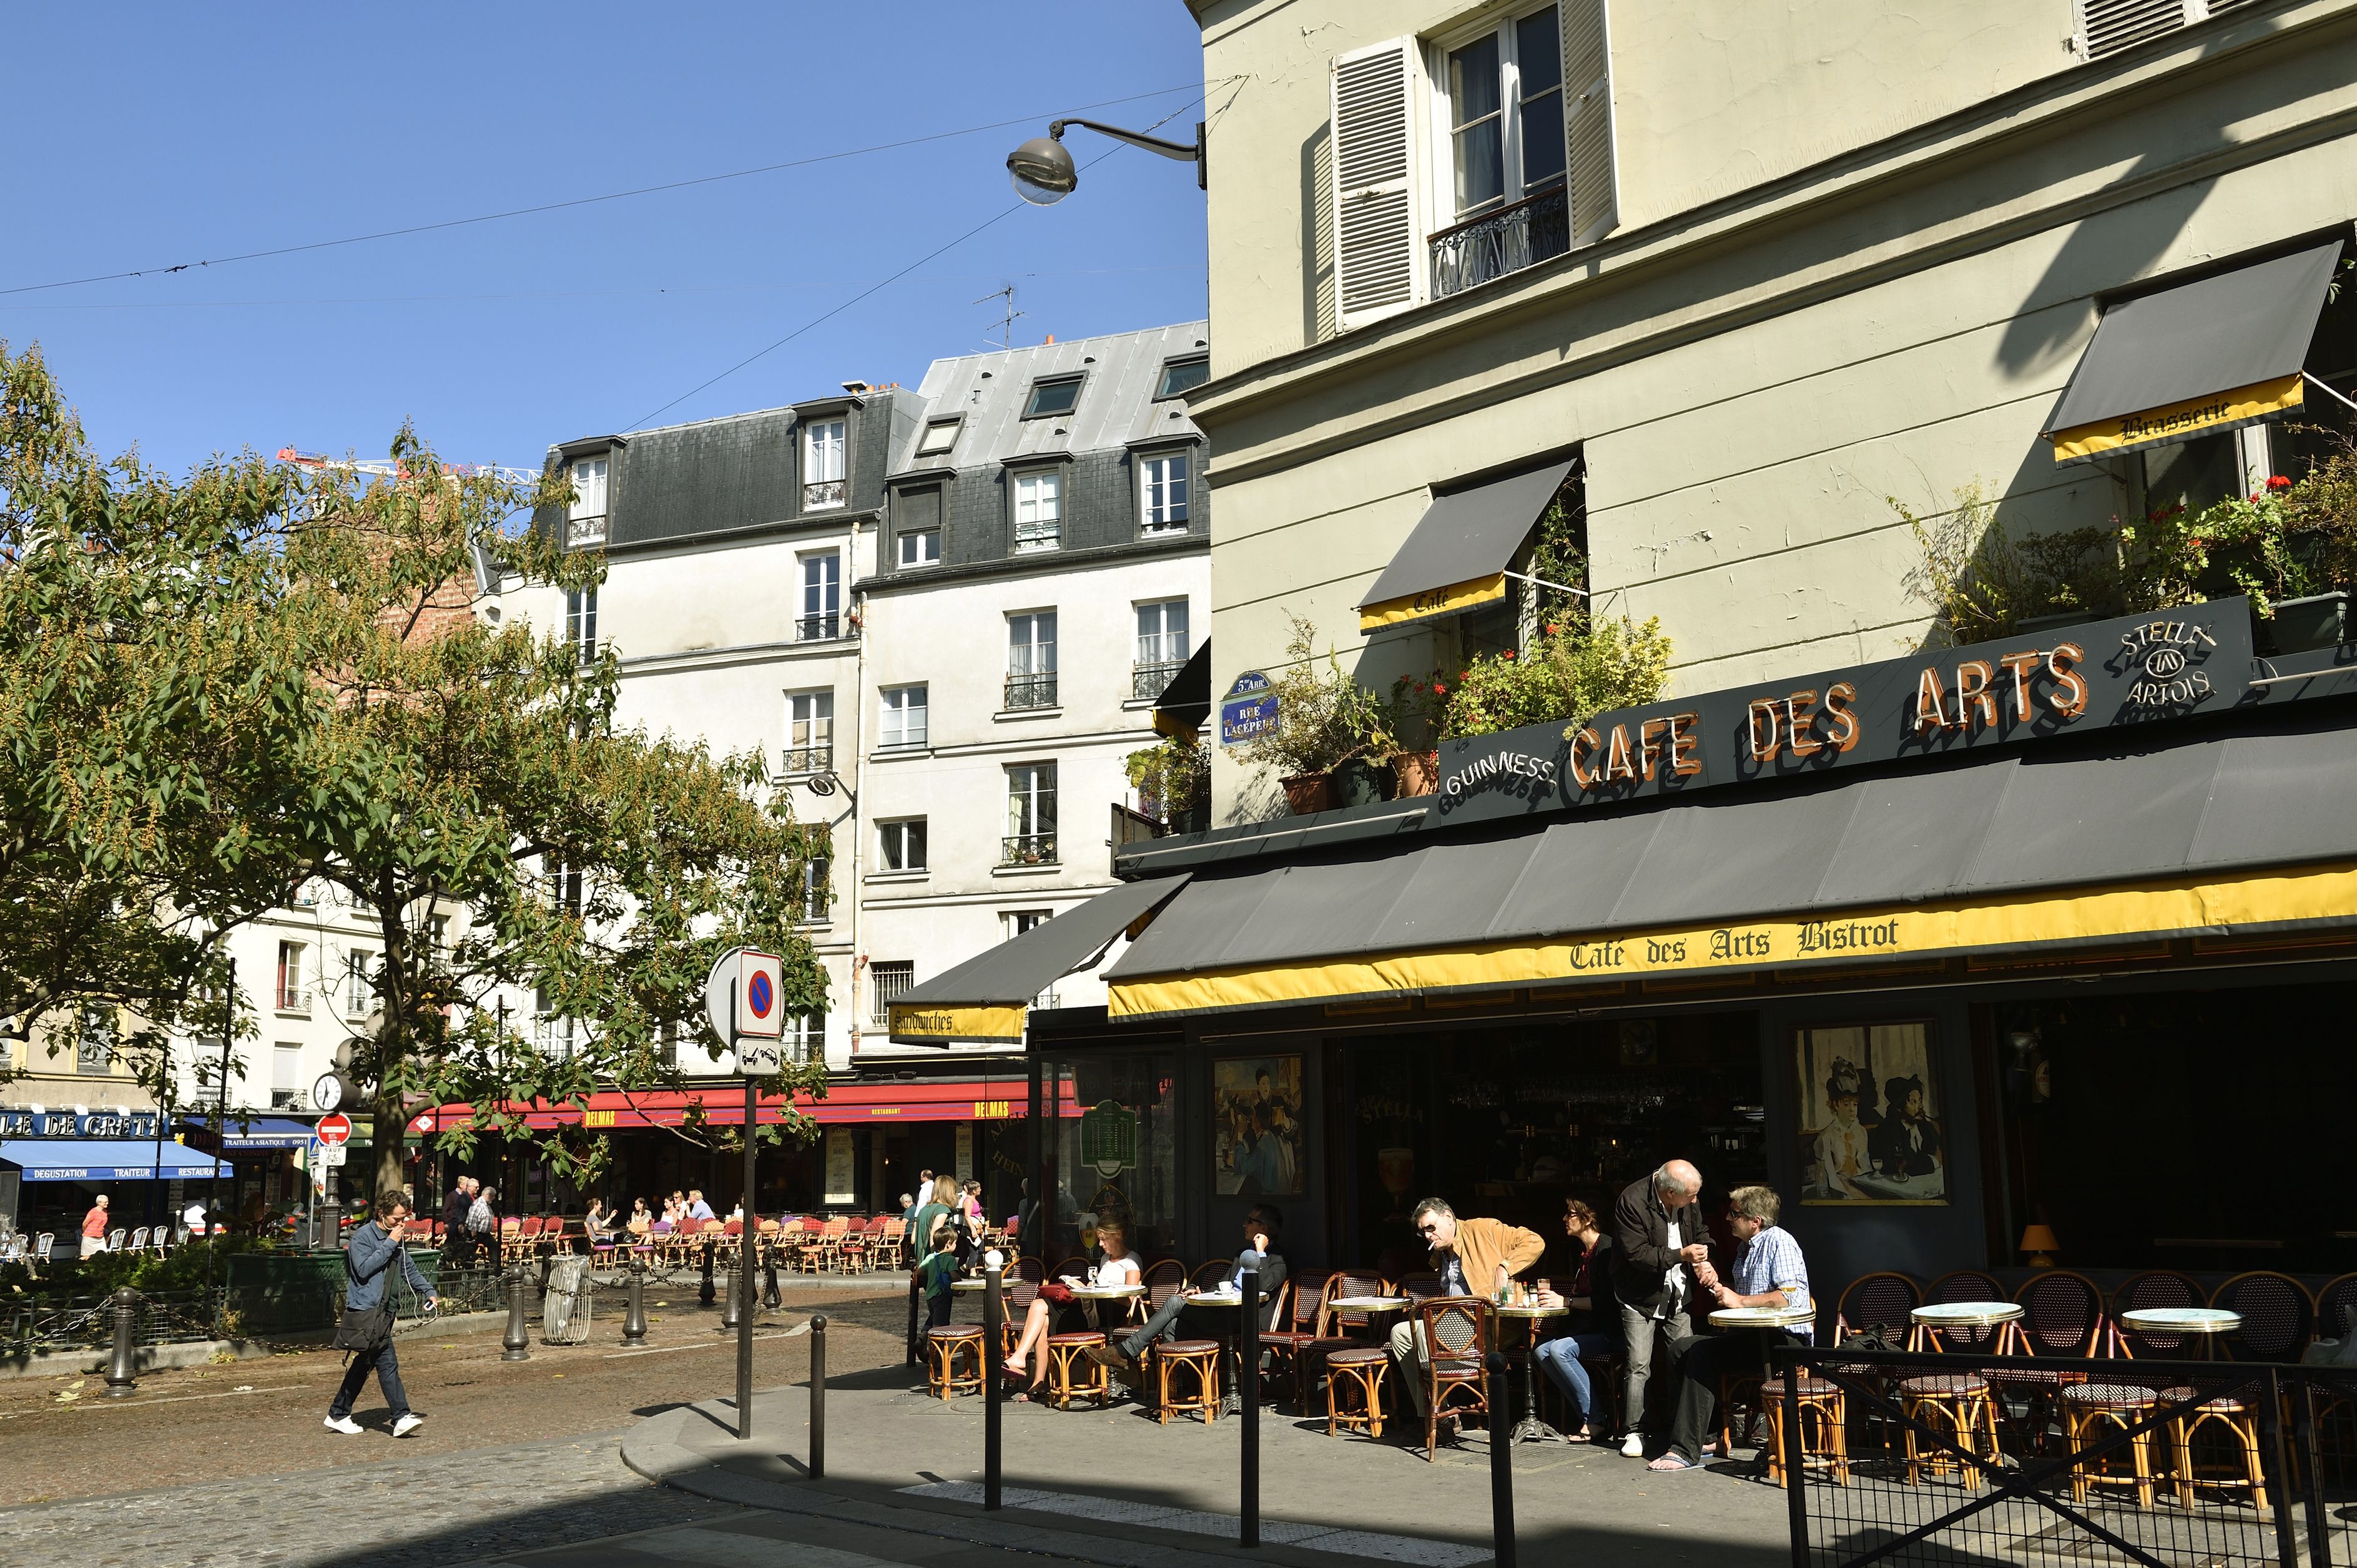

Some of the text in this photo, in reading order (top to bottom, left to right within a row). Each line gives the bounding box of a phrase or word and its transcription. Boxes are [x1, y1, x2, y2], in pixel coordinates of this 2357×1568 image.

[2120, 399, 2231, 444] Brasserie
[1414, 587, 1449, 613] Café
[2125, 671, 2212, 705] ARTOIS
[1748, 682, 1860, 762] DES
[1913, 642, 2089, 736] ARTS
[1224, 717, 1276, 737] LACÉPÈ
[1446, 751, 1554, 795] GUINNESS
[1570, 919, 1900, 970] Café des Arts Bistrot
[895, 1011, 953, 1033] Sandwiches
[586, 1110, 615, 1126] DELMAS
[975, 1101, 1009, 1117] DELMAS
[44, 1115, 76, 1136] DE
[34, 1169, 87, 1178] DEGUSTATION
[114, 1169, 150, 1177] TRAITEUR
